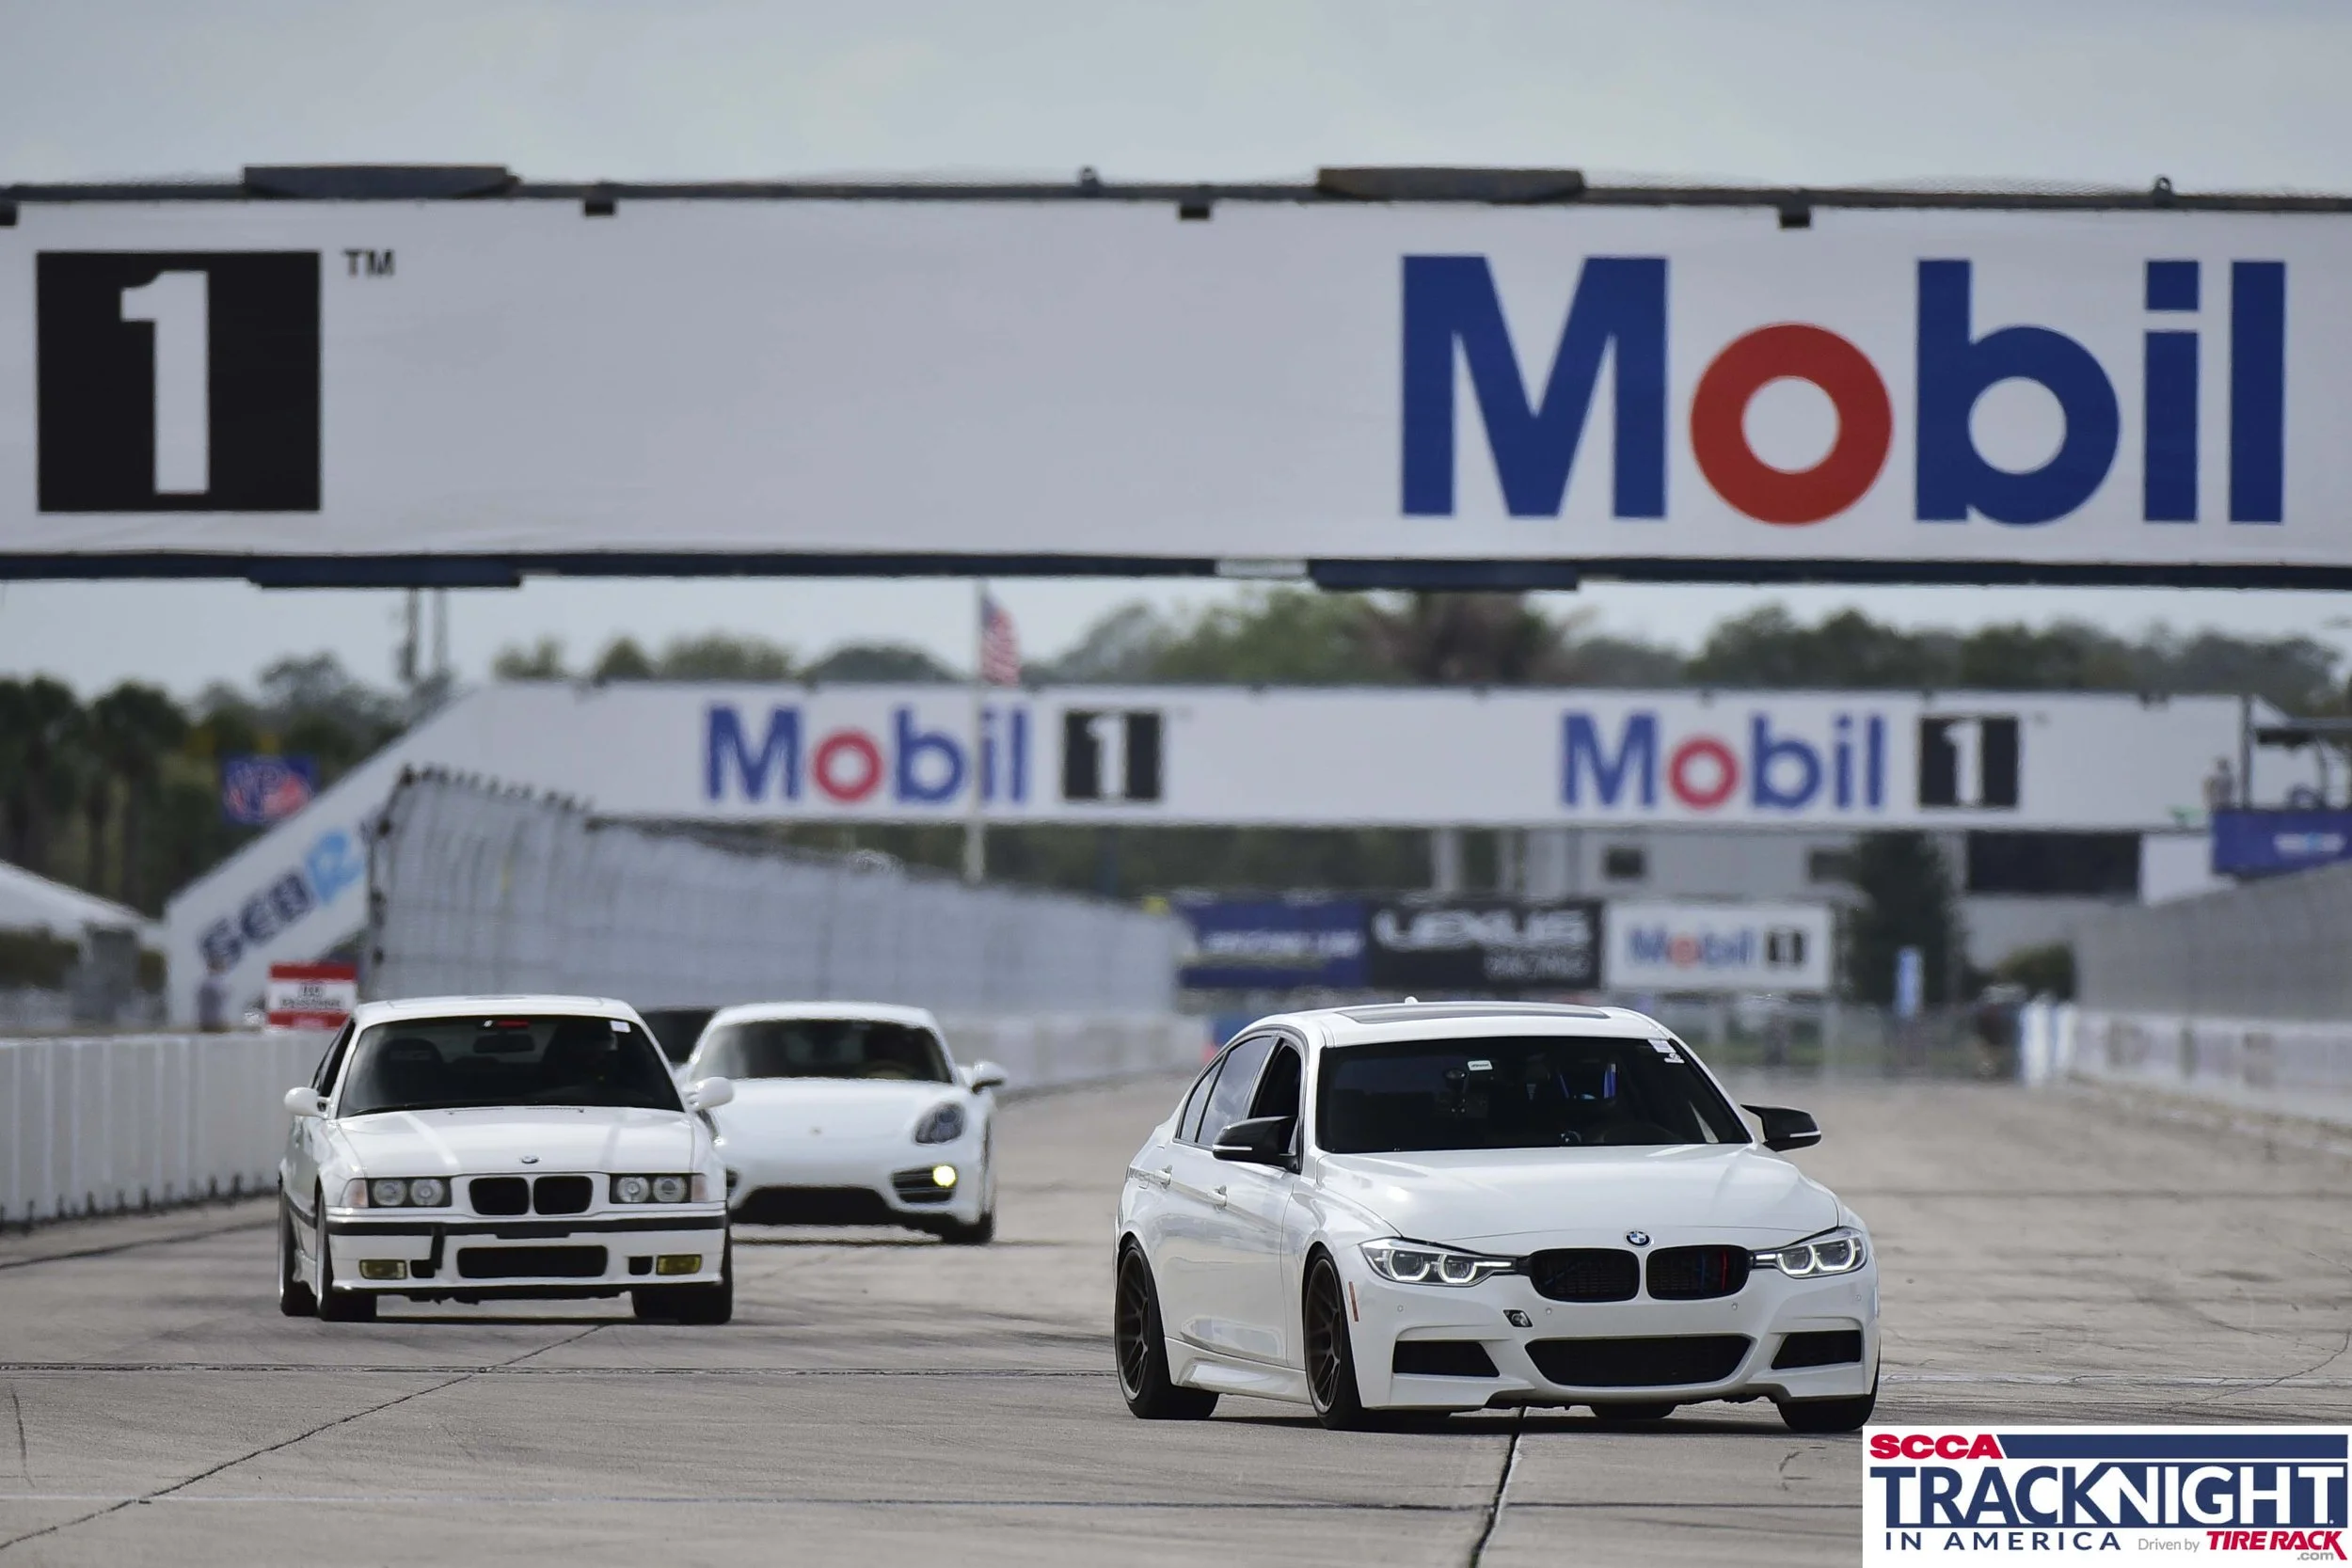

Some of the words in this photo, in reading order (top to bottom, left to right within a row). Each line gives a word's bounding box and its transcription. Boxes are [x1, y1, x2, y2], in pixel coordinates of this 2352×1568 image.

[1400, 254, 2287, 527] Mobil
[705, 704, 1027, 804] Mobil
[1561, 711, 1886, 811] Mobil
